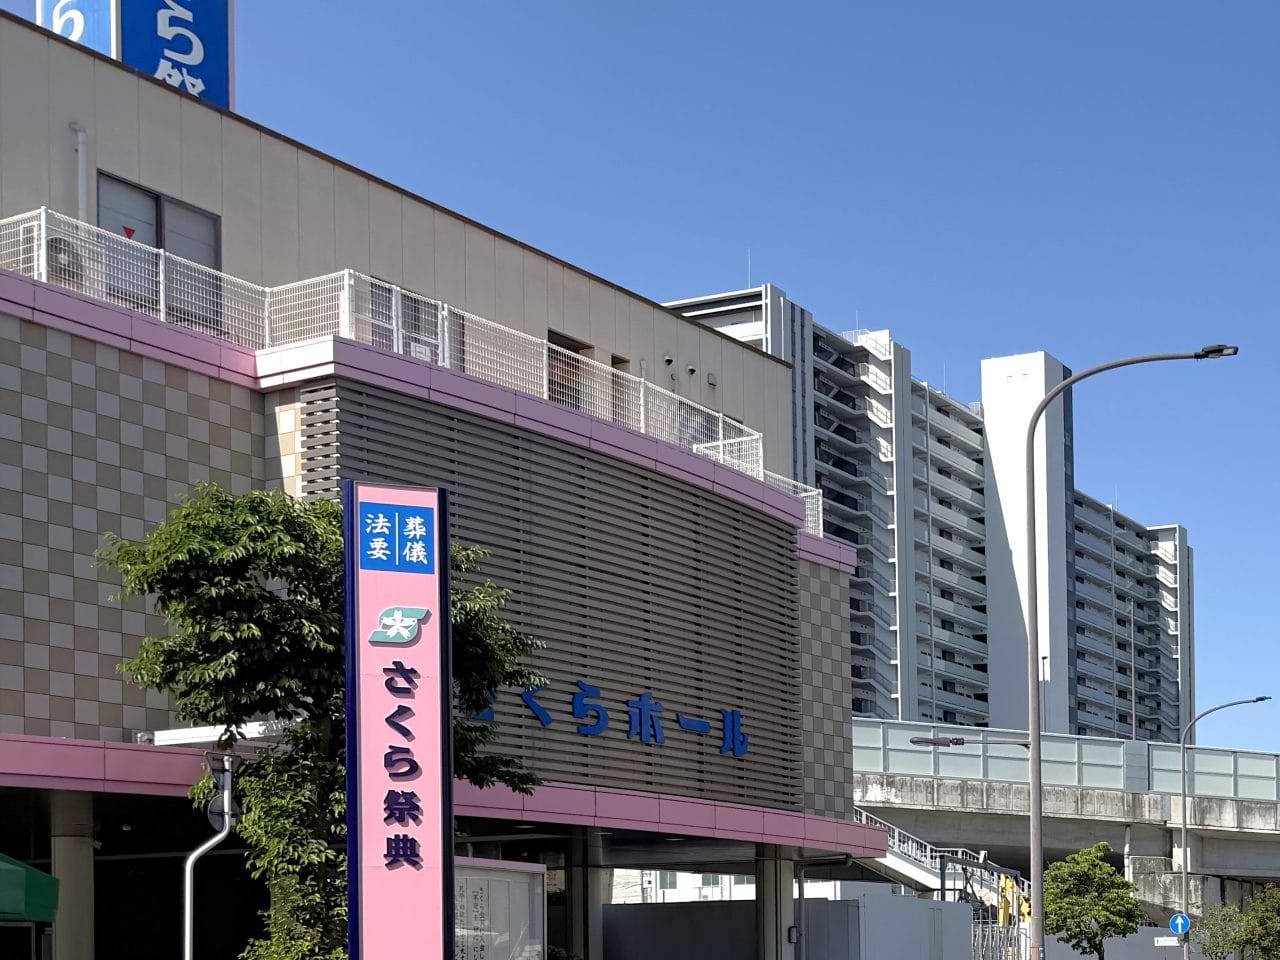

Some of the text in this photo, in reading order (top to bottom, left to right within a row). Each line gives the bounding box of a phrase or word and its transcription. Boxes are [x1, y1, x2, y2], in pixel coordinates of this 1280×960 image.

[365, 513, 392, 561] 法要
[402, 515, 428, 565] 葬儀
[472, 679, 748, 757] くらホール
[382, 660, 423, 871] さくら祭典
